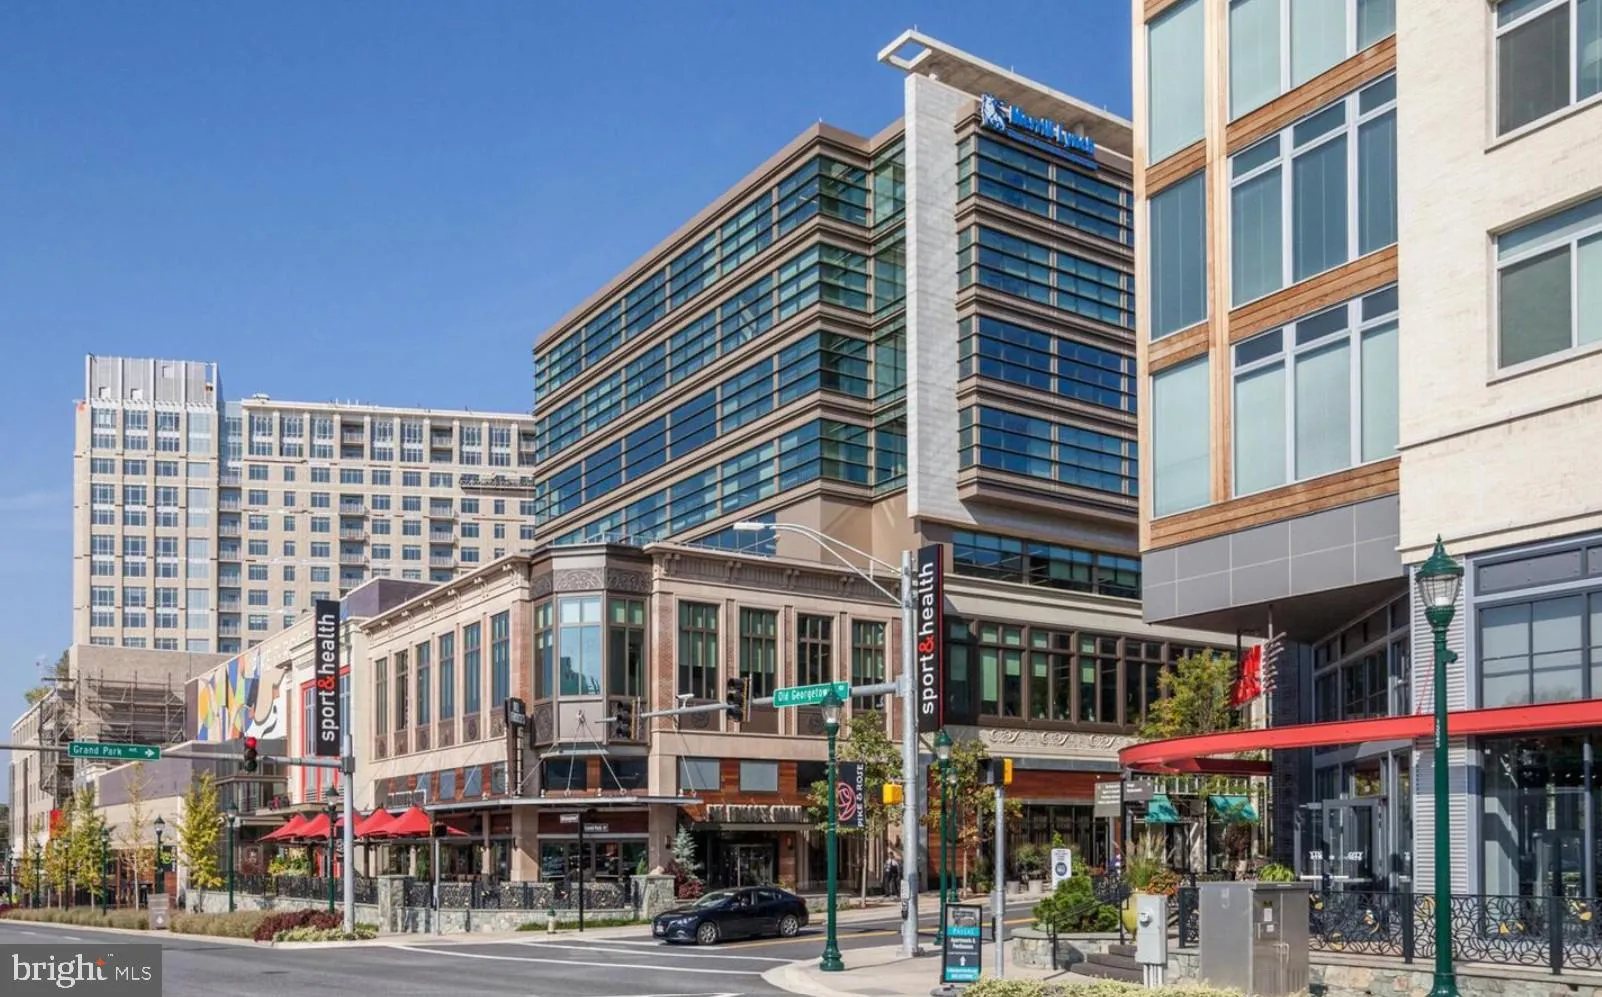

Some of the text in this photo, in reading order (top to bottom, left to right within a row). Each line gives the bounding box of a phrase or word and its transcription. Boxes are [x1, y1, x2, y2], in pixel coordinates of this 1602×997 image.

[918, 562, 937, 714] sport&health
[318, 614, 339, 741] sport&health
[777, 687, 829, 702] Old Georgetow
[73, 744, 99, 755] Grand
[102, 746, 122, 757] Park
[856, 764, 864, 792] ROSE
